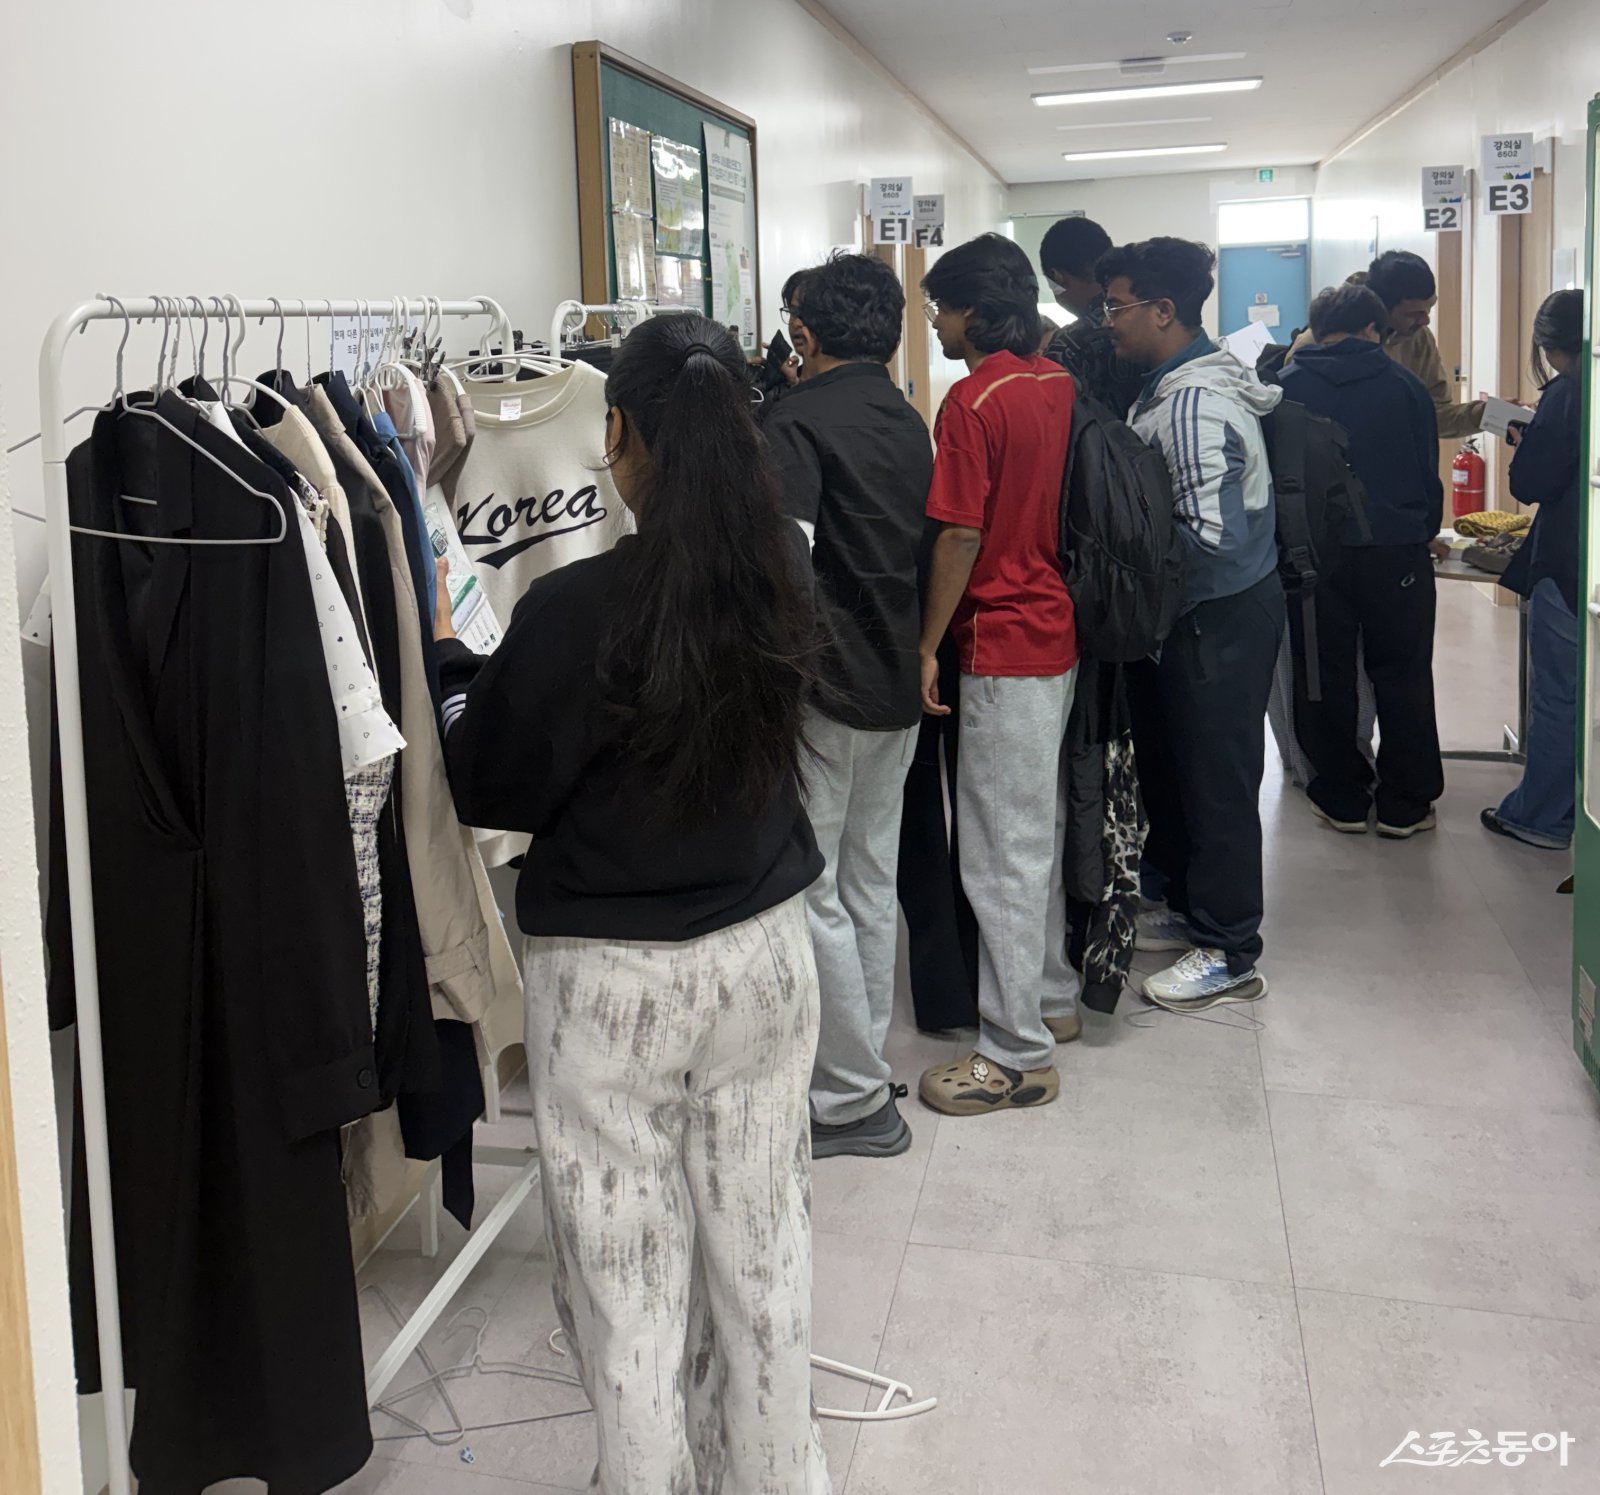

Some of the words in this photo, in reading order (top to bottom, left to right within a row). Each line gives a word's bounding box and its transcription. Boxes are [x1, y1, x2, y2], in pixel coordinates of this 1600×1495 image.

[1493, 139, 1522, 151] 강의실
[1497, 150, 1518, 158] 6502
[1431, 170, 1455, 179] 강의실
[879, 183, 903, 192] 강의실
[1489, 183, 1529, 212] E3
[1424, 207, 1457, 229] E2
[880, 218, 907, 241] E1
[916, 227, 944, 248] F4
